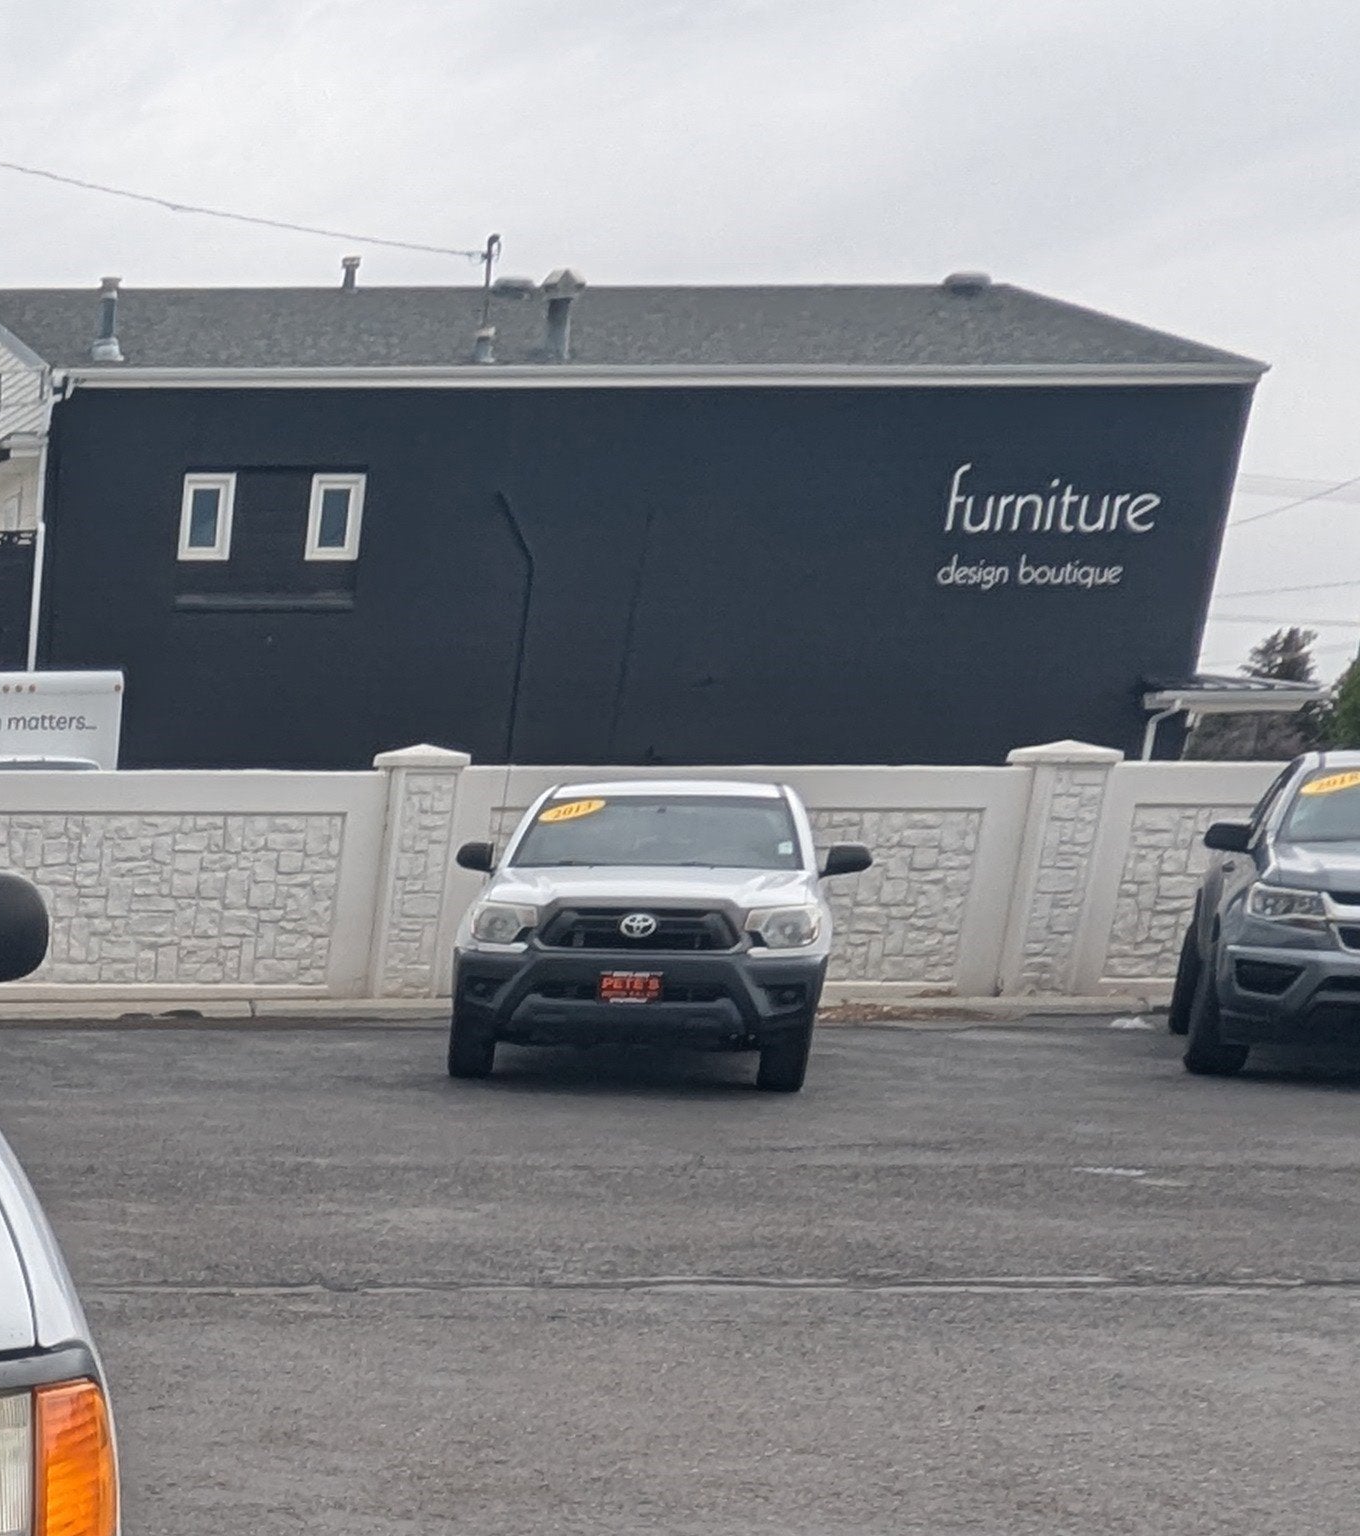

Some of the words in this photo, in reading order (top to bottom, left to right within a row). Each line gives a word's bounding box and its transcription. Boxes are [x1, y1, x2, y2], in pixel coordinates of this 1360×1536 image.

[944, 463, 1161, 533] furniture
[937, 554, 1010, 590] design
[1018, 553, 1124, 589] boutique
